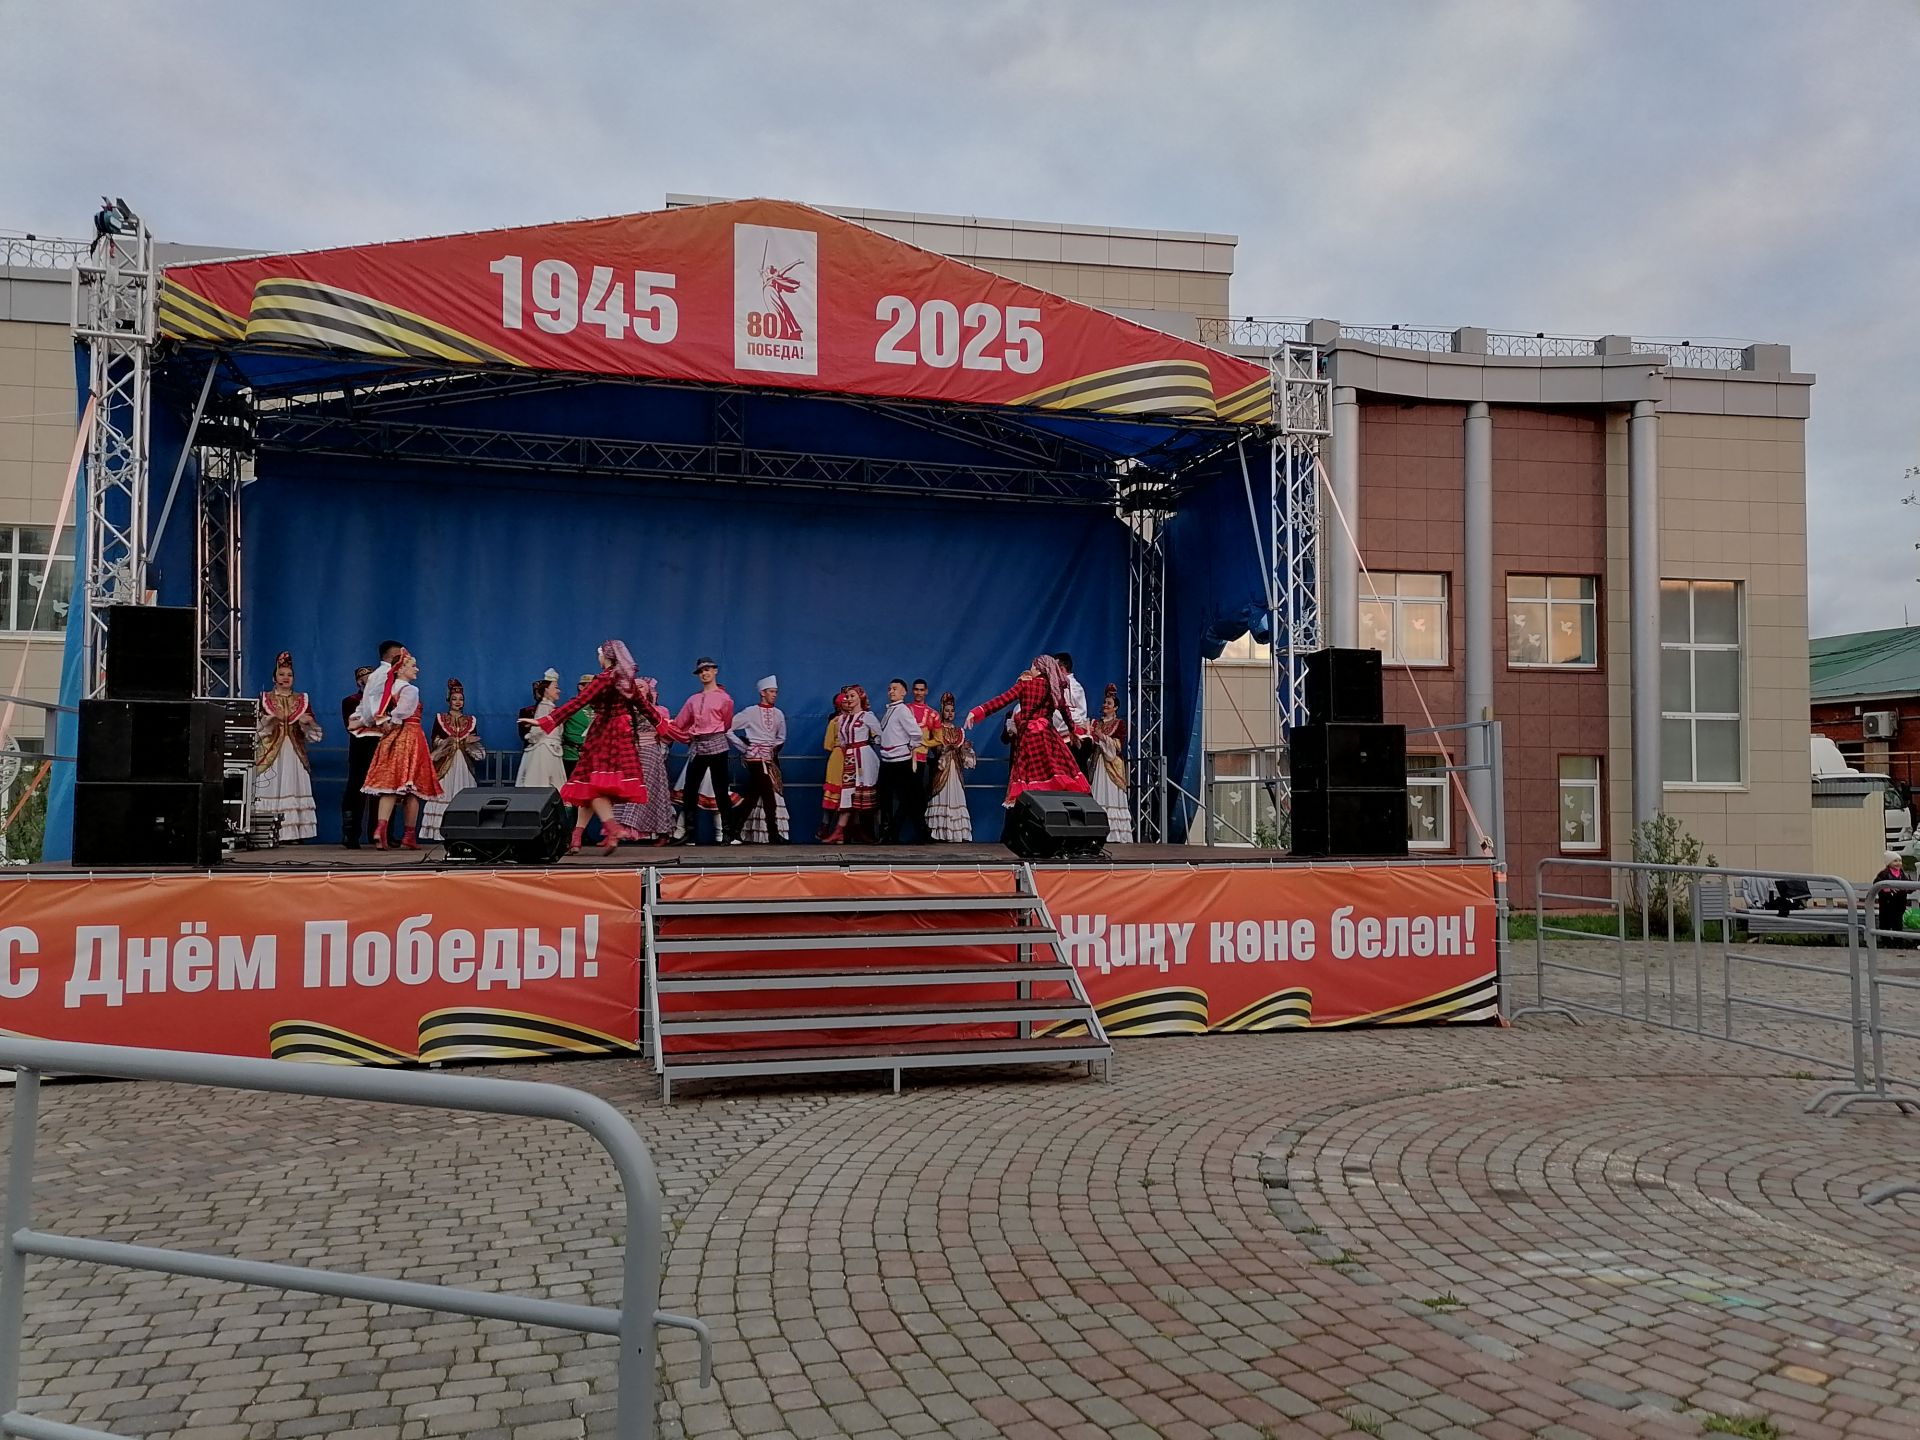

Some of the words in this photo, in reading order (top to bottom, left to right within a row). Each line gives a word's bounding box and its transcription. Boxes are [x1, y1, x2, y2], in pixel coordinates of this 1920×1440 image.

[489, 255, 680, 345] 1945
[747, 311, 778, 339] 80
[747, 342, 805, 361] ПОБЕДА!
[874, 295, 1045, 375] 2025
[0, 926, 40, 999] С
[64, 921, 278, 1009] Днём
[303, 913, 600, 992] Победы!
[1209, 918, 1316, 964] көне
[1330, 905, 1477, 960] белән!
